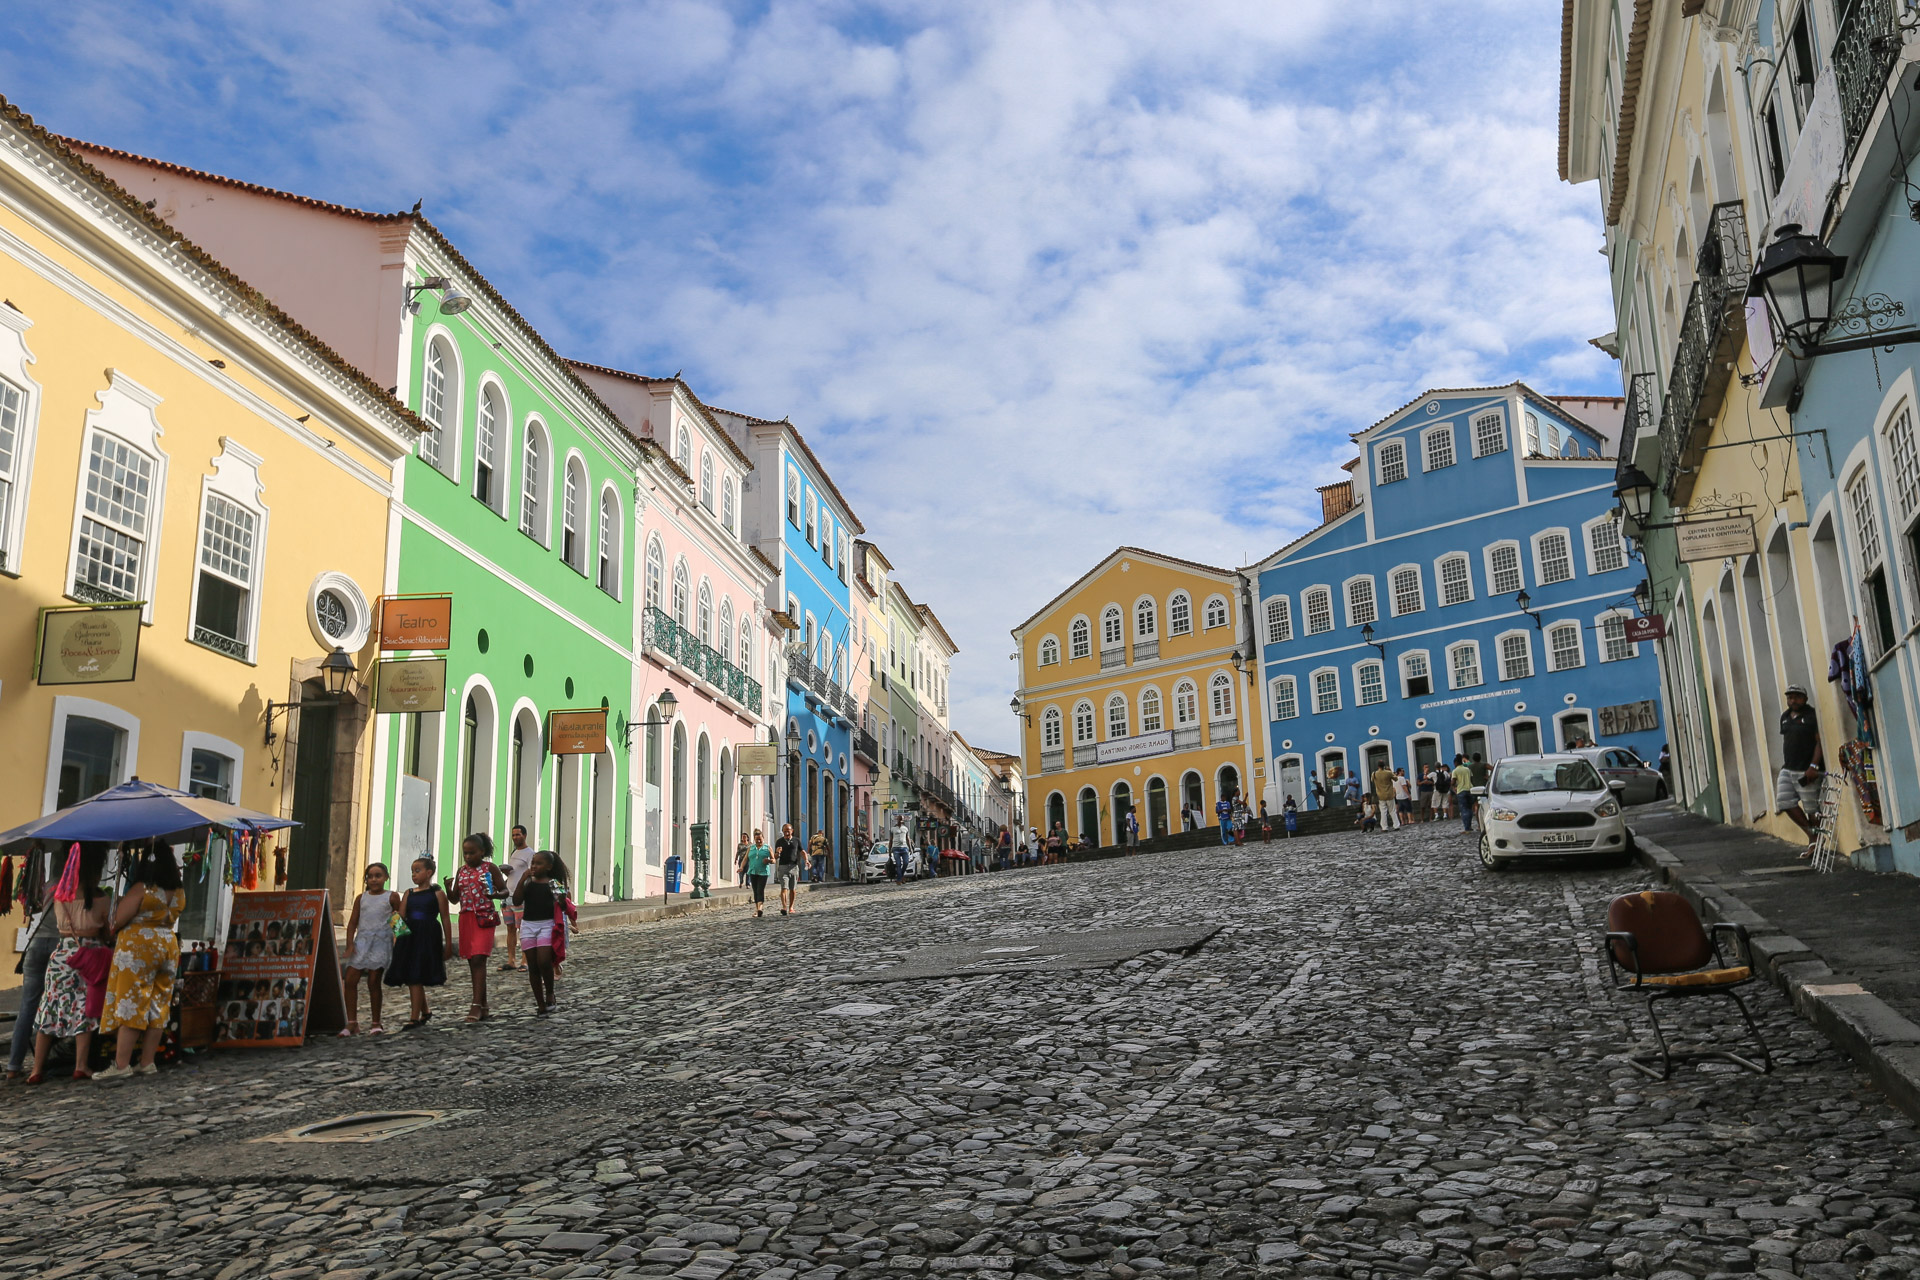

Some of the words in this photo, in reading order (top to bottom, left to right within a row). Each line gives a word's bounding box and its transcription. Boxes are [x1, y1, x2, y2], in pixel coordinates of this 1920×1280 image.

[395, 613, 438, 629] Teatro
[557, 721, 605, 731] Restaurante
[1100, 745, 1128, 756] CANTINHO
[1128, 742, 1147, 751] JORGE
[1148, 738, 1169, 748] AMADO
